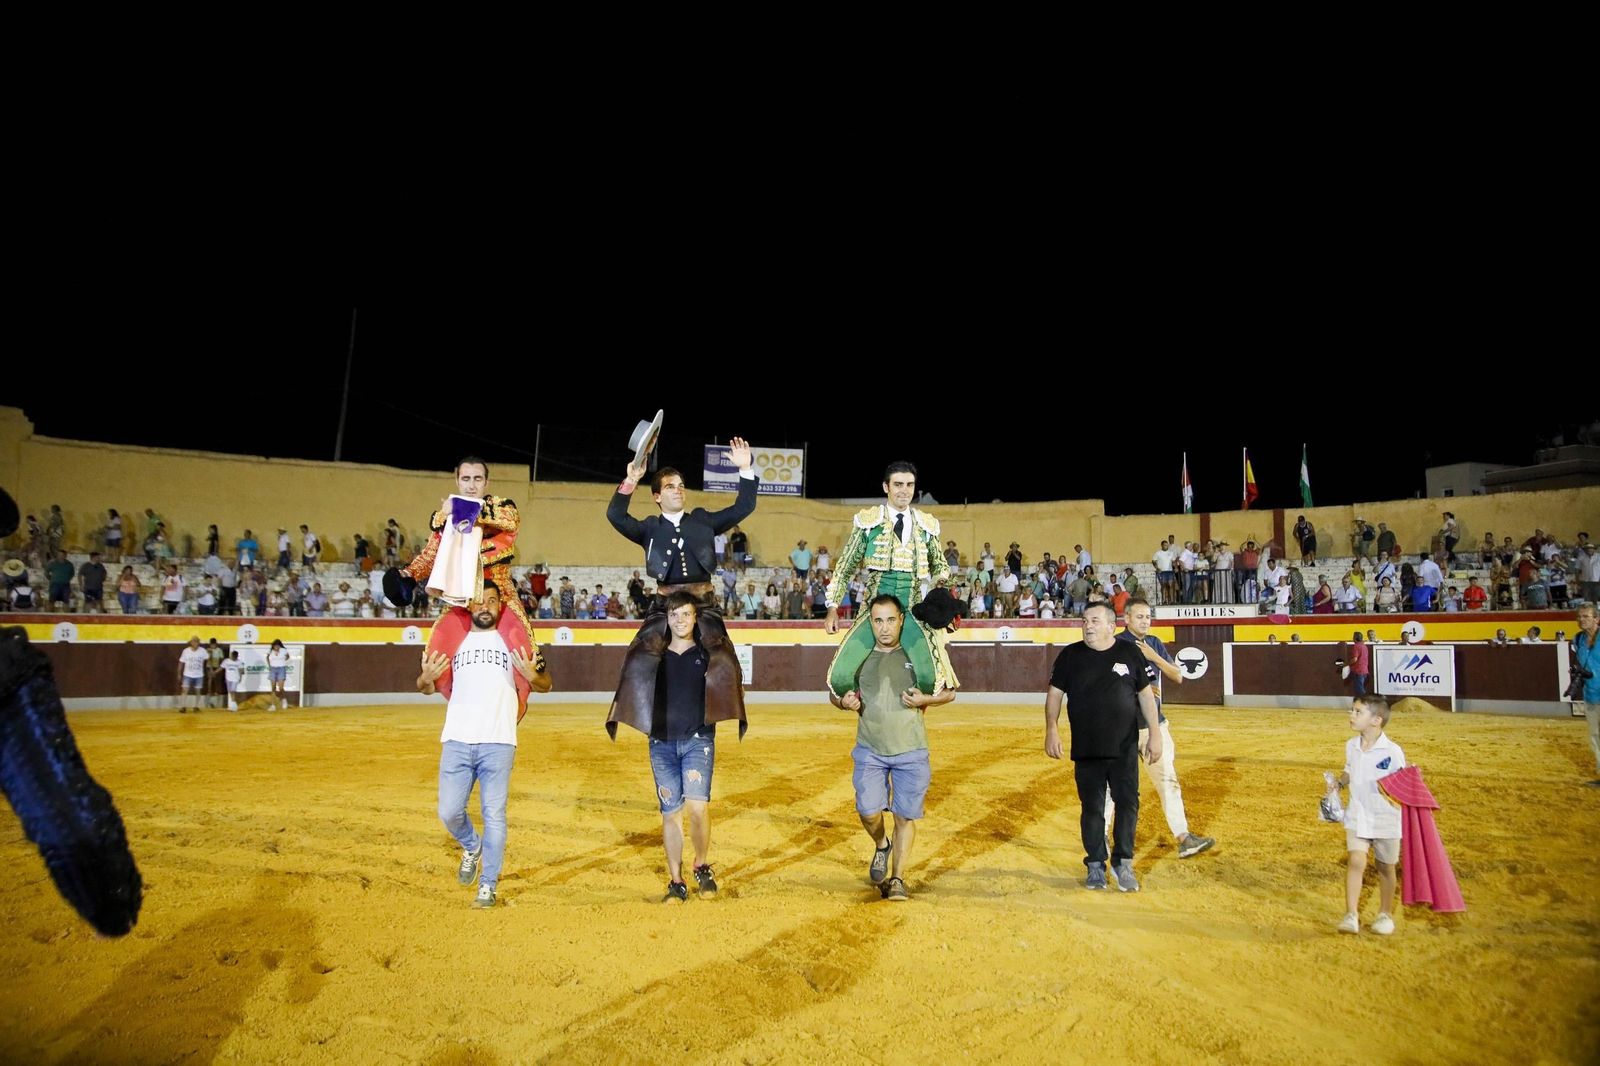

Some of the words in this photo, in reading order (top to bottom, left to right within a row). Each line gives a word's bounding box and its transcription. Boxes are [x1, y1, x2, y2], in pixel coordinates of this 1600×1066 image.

[1175, 608, 1235, 617] TORILES
[61, 629, 70, 638] 5
[244, 630, 252, 638] 5
[409, 631, 416, 640] 5
[561, 632, 568, 640] 5
[1002, 631, 1008, 640] 5
[454, 649, 508, 672] HILFIGER
[1388, 672, 1440, 686] Mayfra
